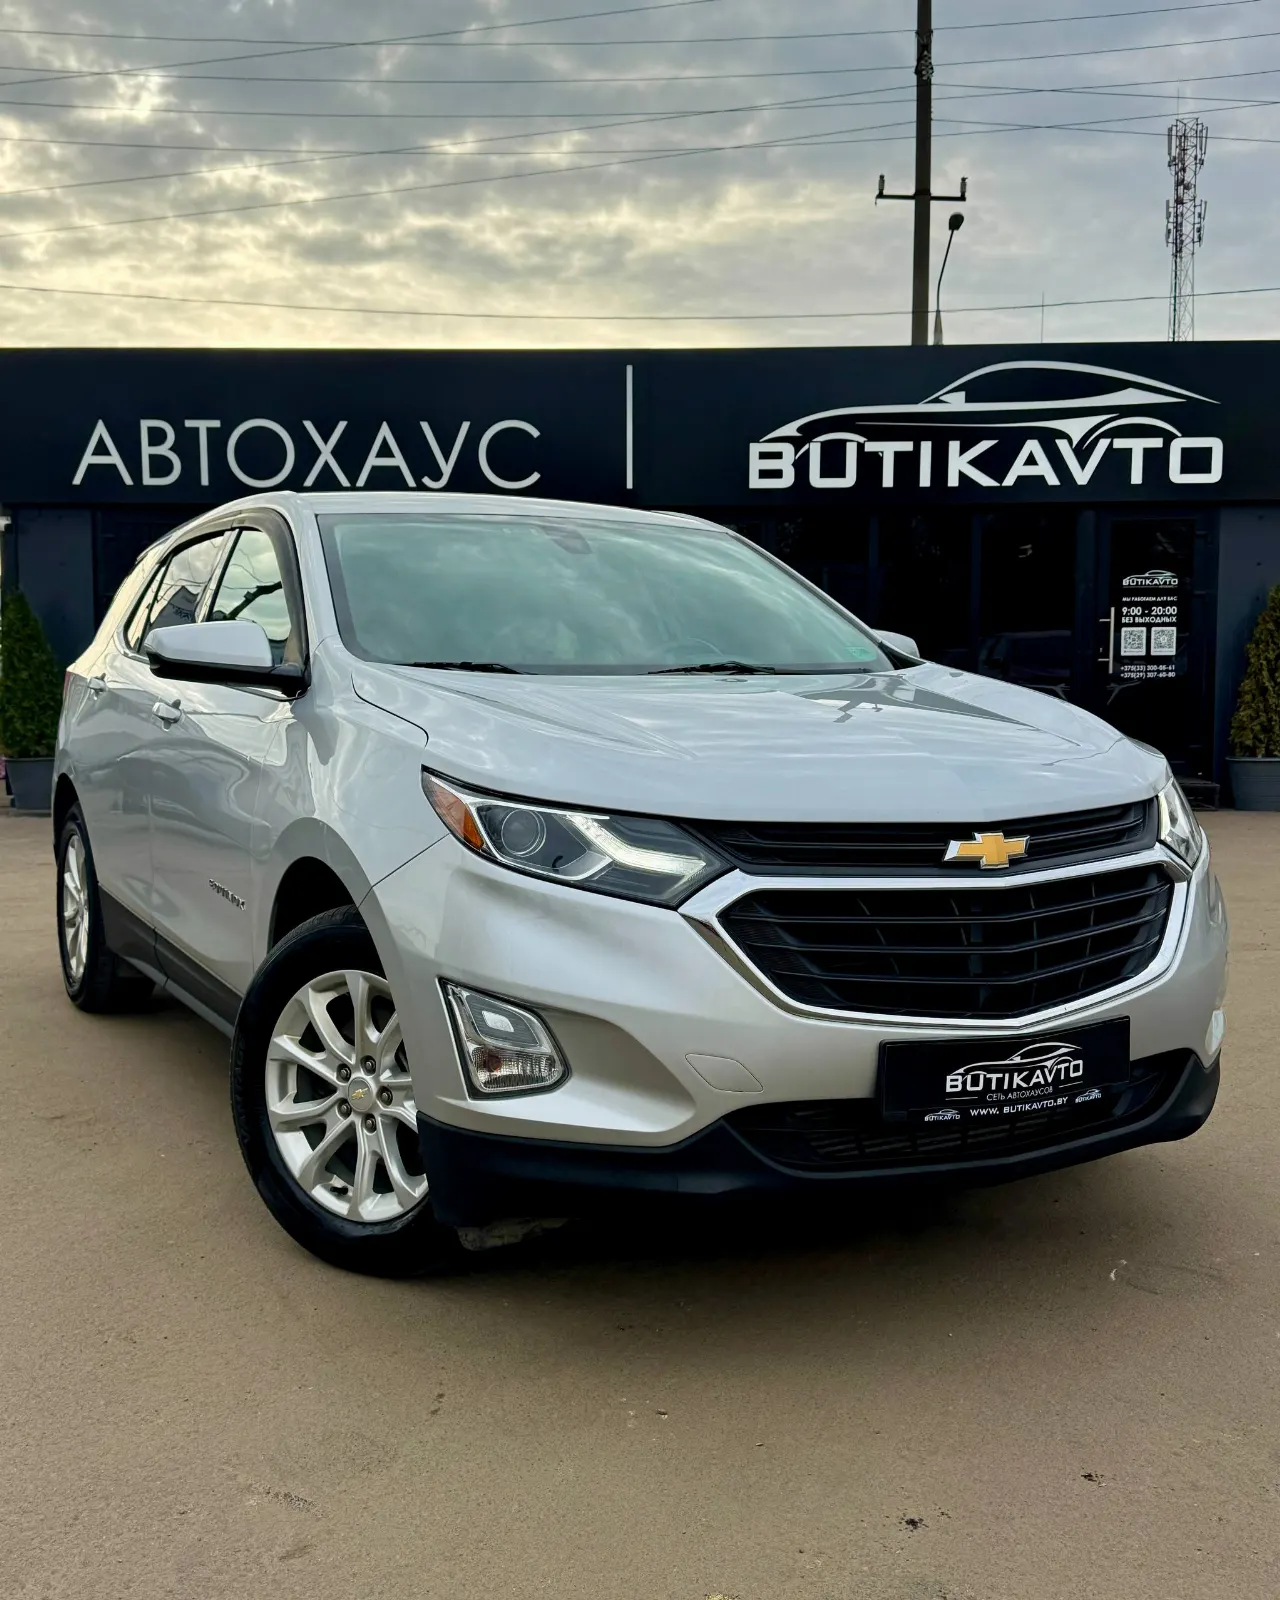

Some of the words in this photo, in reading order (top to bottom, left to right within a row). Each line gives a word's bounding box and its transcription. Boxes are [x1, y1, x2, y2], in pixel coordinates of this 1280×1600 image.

[72, 418, 541, 489] АВТОХАУС
[748, 436, 1224, 489] BUTIKAVTO
[1122, 578, 1178, 586] BUTIKAVTO
[1121, 606, 1142, 616] 9:00
[1151, 606, 1177, 615] 20:00
[945, 1059, 1084, 1093] BUTIKAVTO
[986, 1092, 1006, 1101] СЕТЬ
[1006, 1085, 1054, 1100] АВТОХАУСОВ
